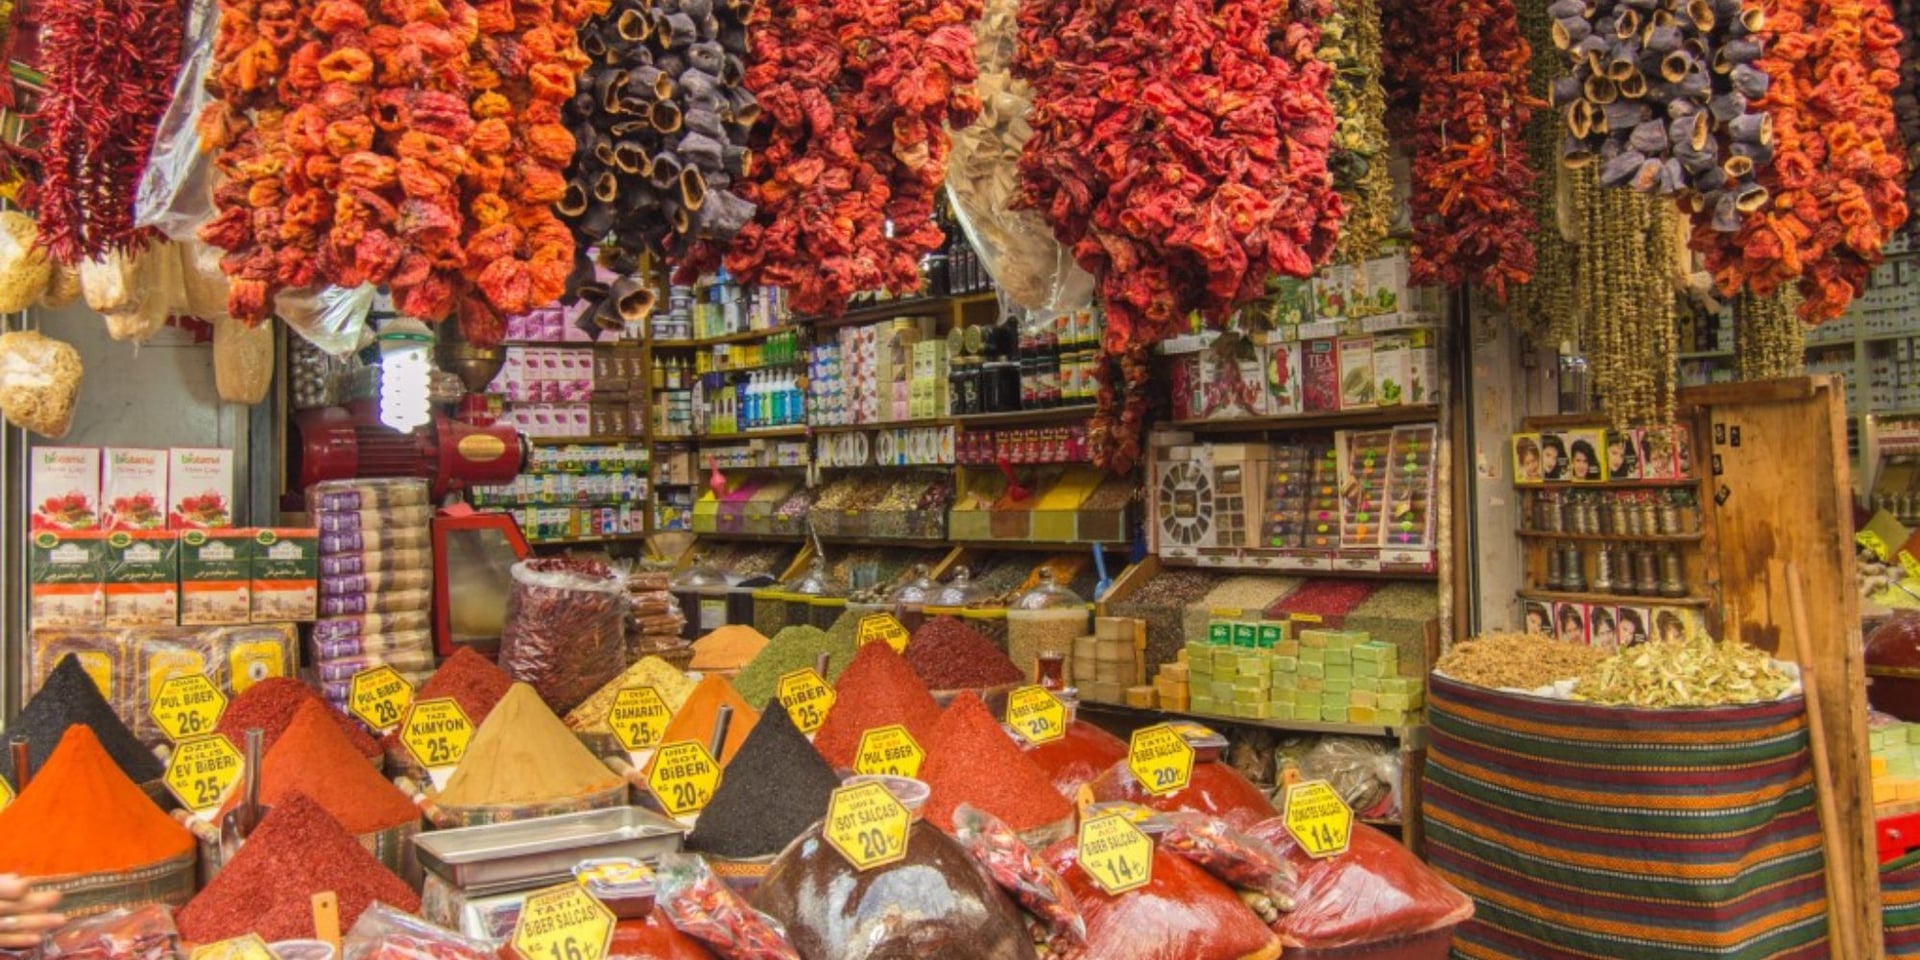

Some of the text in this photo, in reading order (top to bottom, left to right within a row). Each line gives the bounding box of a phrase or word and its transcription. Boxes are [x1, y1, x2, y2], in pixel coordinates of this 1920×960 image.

[1308, 355, 1334, 370] TEA
[160, 696, 181, 709] PUL
[615, 704, 663, 720] BAHARATI
[863, 751, 884, 765] PUL
[175, 763, 191, 778] EV
[535, 897, 580, 915] TATLI
